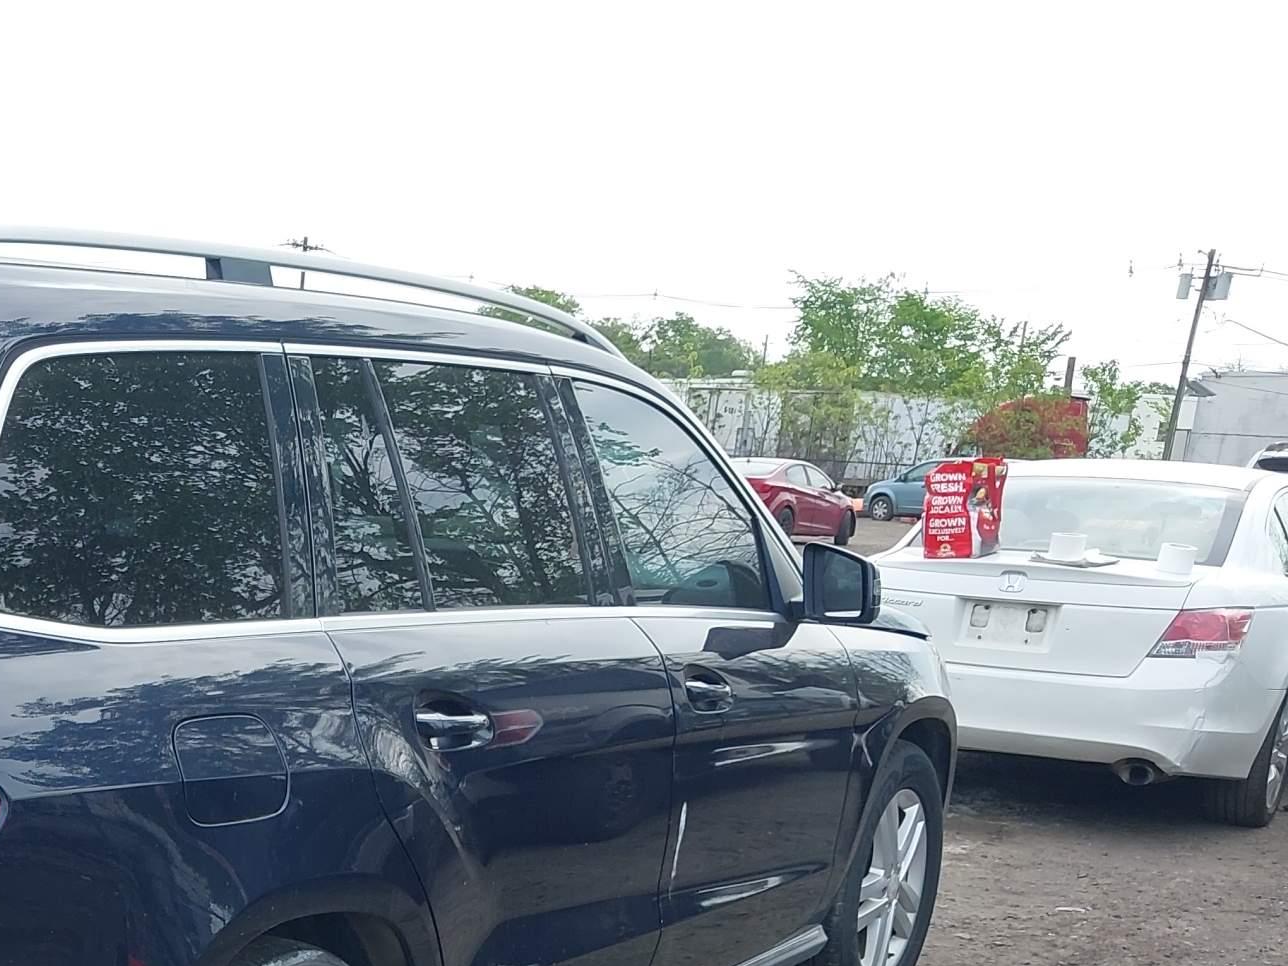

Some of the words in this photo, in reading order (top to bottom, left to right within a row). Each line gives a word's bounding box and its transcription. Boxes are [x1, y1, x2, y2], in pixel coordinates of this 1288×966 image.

[930, 472, 966, 481] GROWN
[930, 482, 966, 493] FRESH.
[932, 495, 963, 505] GROWN
[929, 517, 966, 528] GROWN
